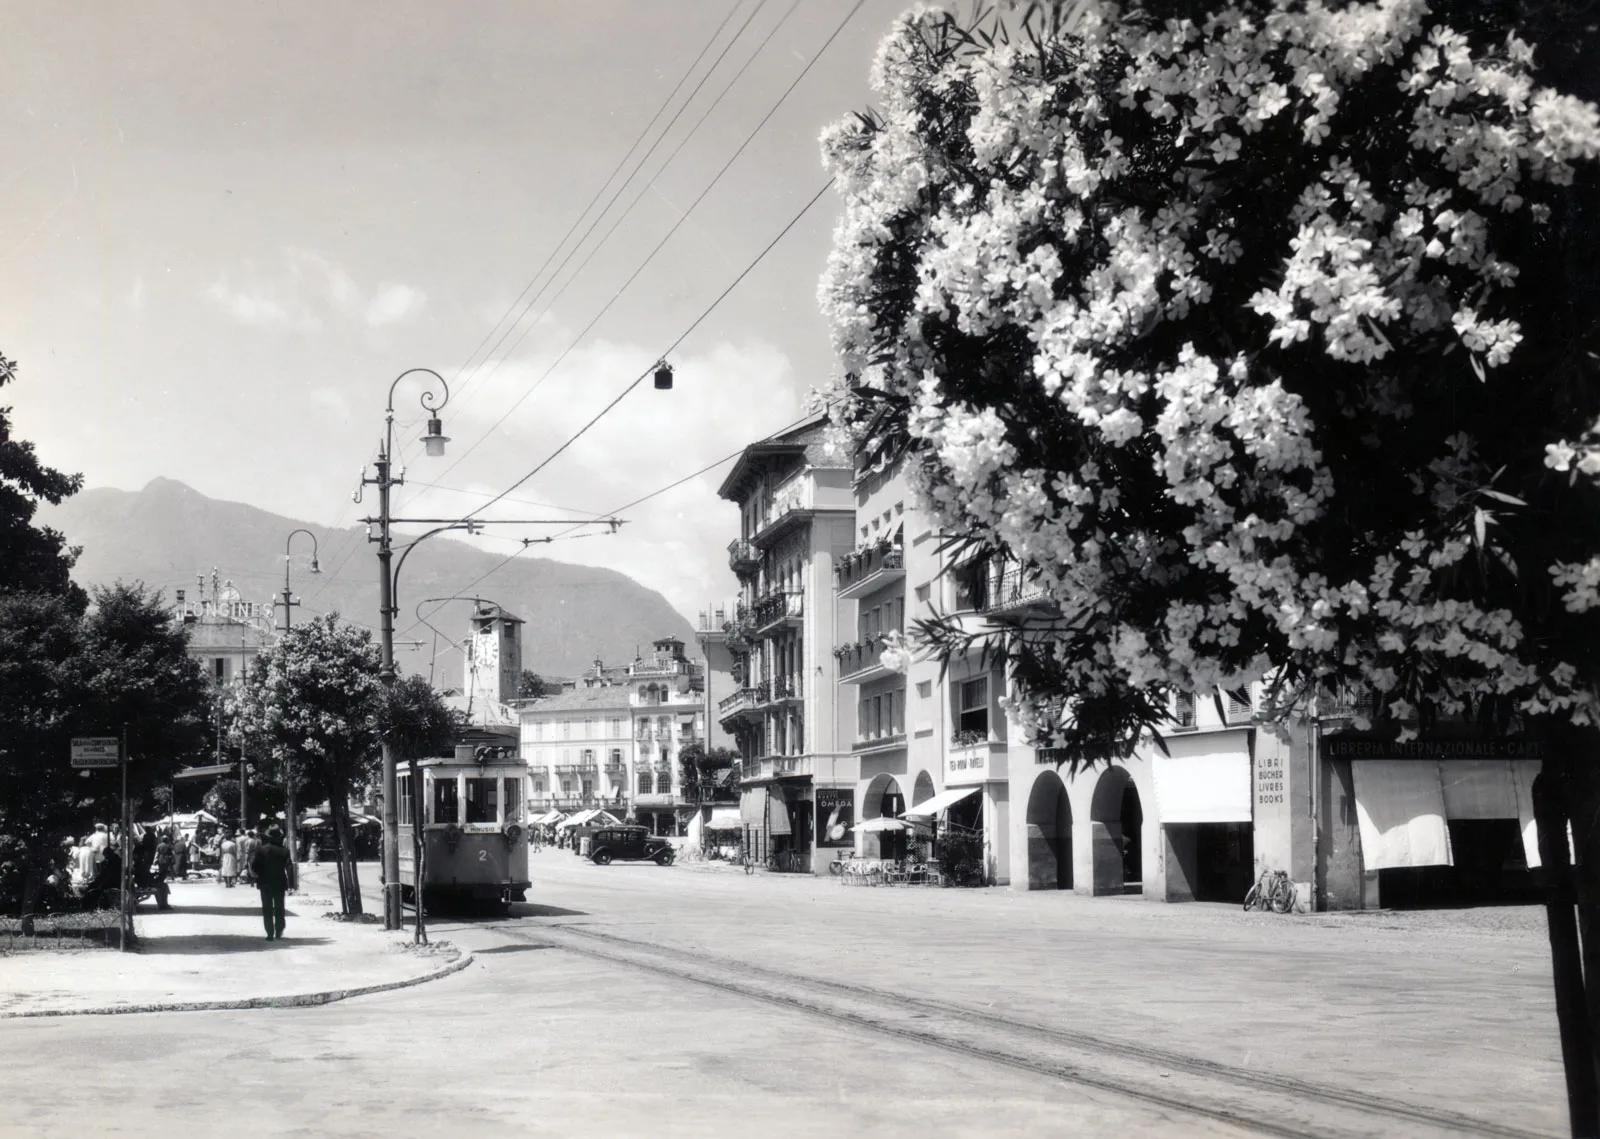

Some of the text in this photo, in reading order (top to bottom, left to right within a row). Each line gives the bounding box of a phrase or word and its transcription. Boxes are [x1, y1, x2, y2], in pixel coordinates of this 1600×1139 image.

[184, 602, 274, 618] LONGINES
[1329, 741, 1385, 756] LIBRERIA
[1390, 741, 1496, 756] INTERNAZIONALE
[1258, 758, 1284, 768] LIBRI
[1258, 782, 1284, 792] LIVRES
[1258, 794, 1284, 804] BOOKS
[478, 849, 487, 861] 2
